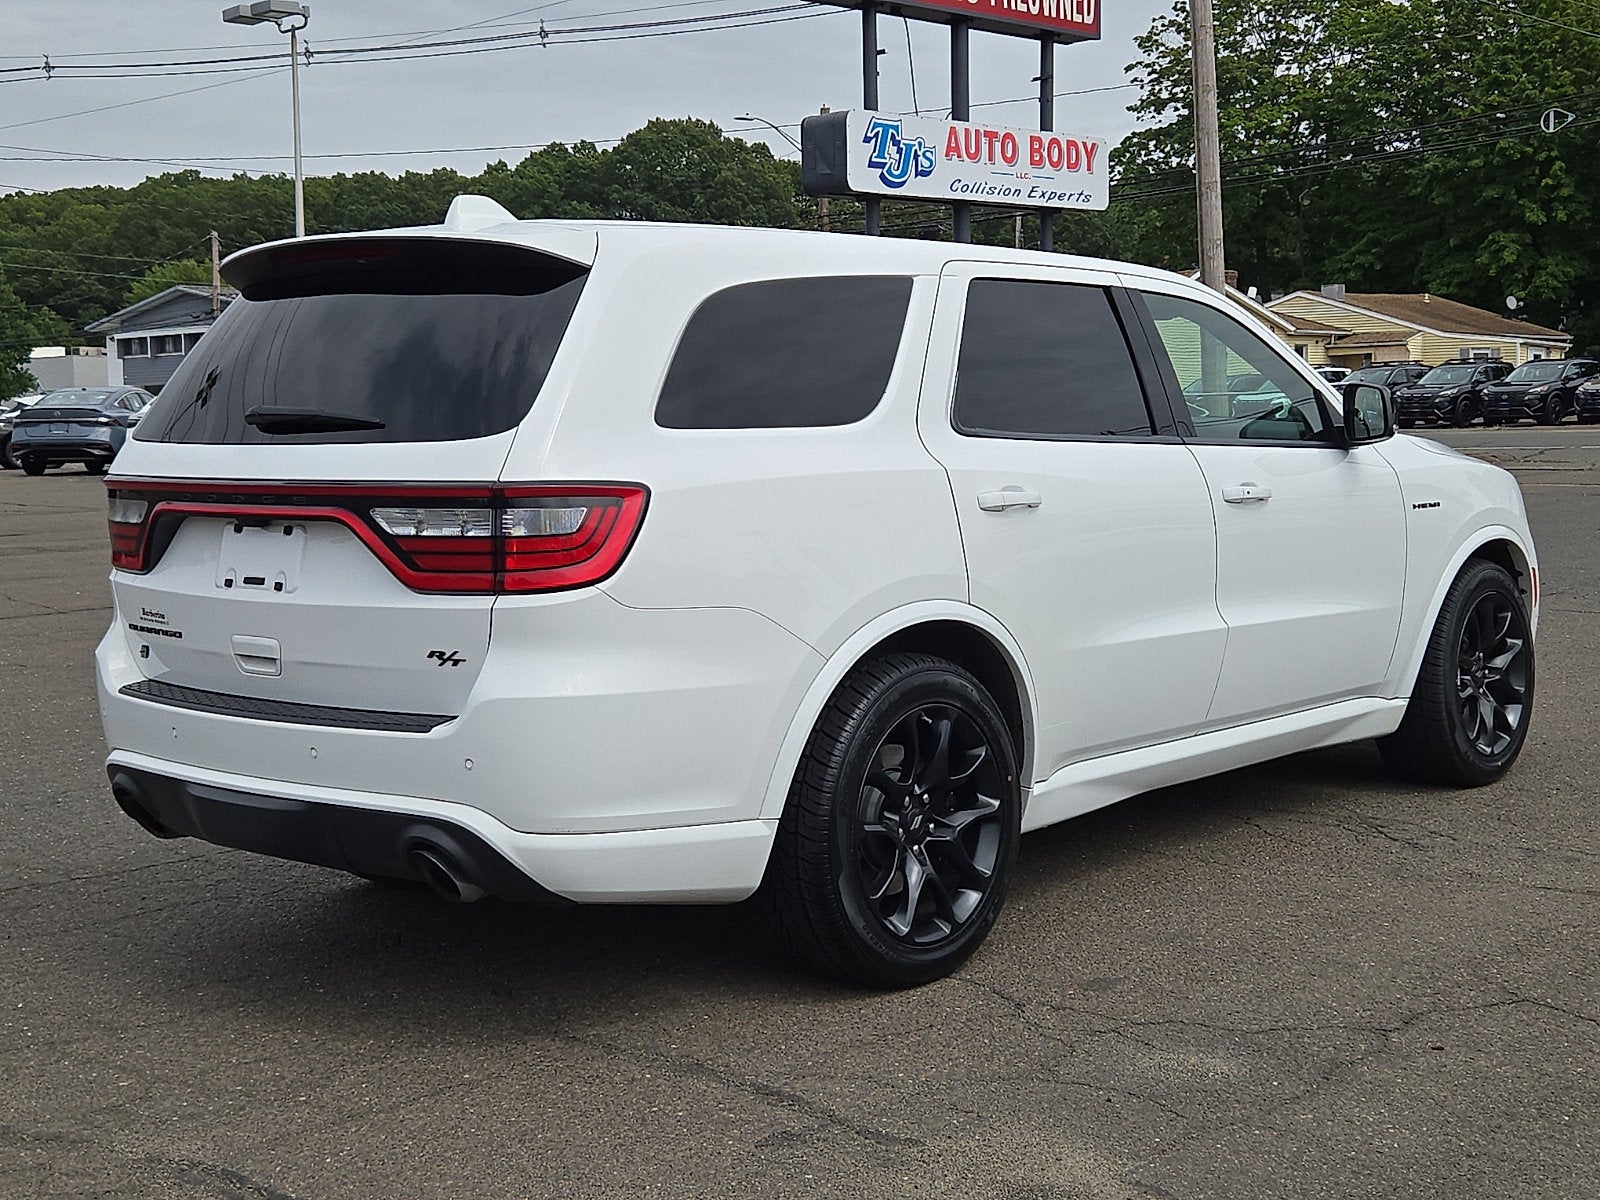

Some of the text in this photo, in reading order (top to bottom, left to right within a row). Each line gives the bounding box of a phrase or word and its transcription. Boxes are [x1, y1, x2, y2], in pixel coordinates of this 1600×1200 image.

[944, 126, 1098, 174] AUTO BODY
[950, 179, 1092, 204] Collision Experts
[426, 650, 467, 667] R/T
